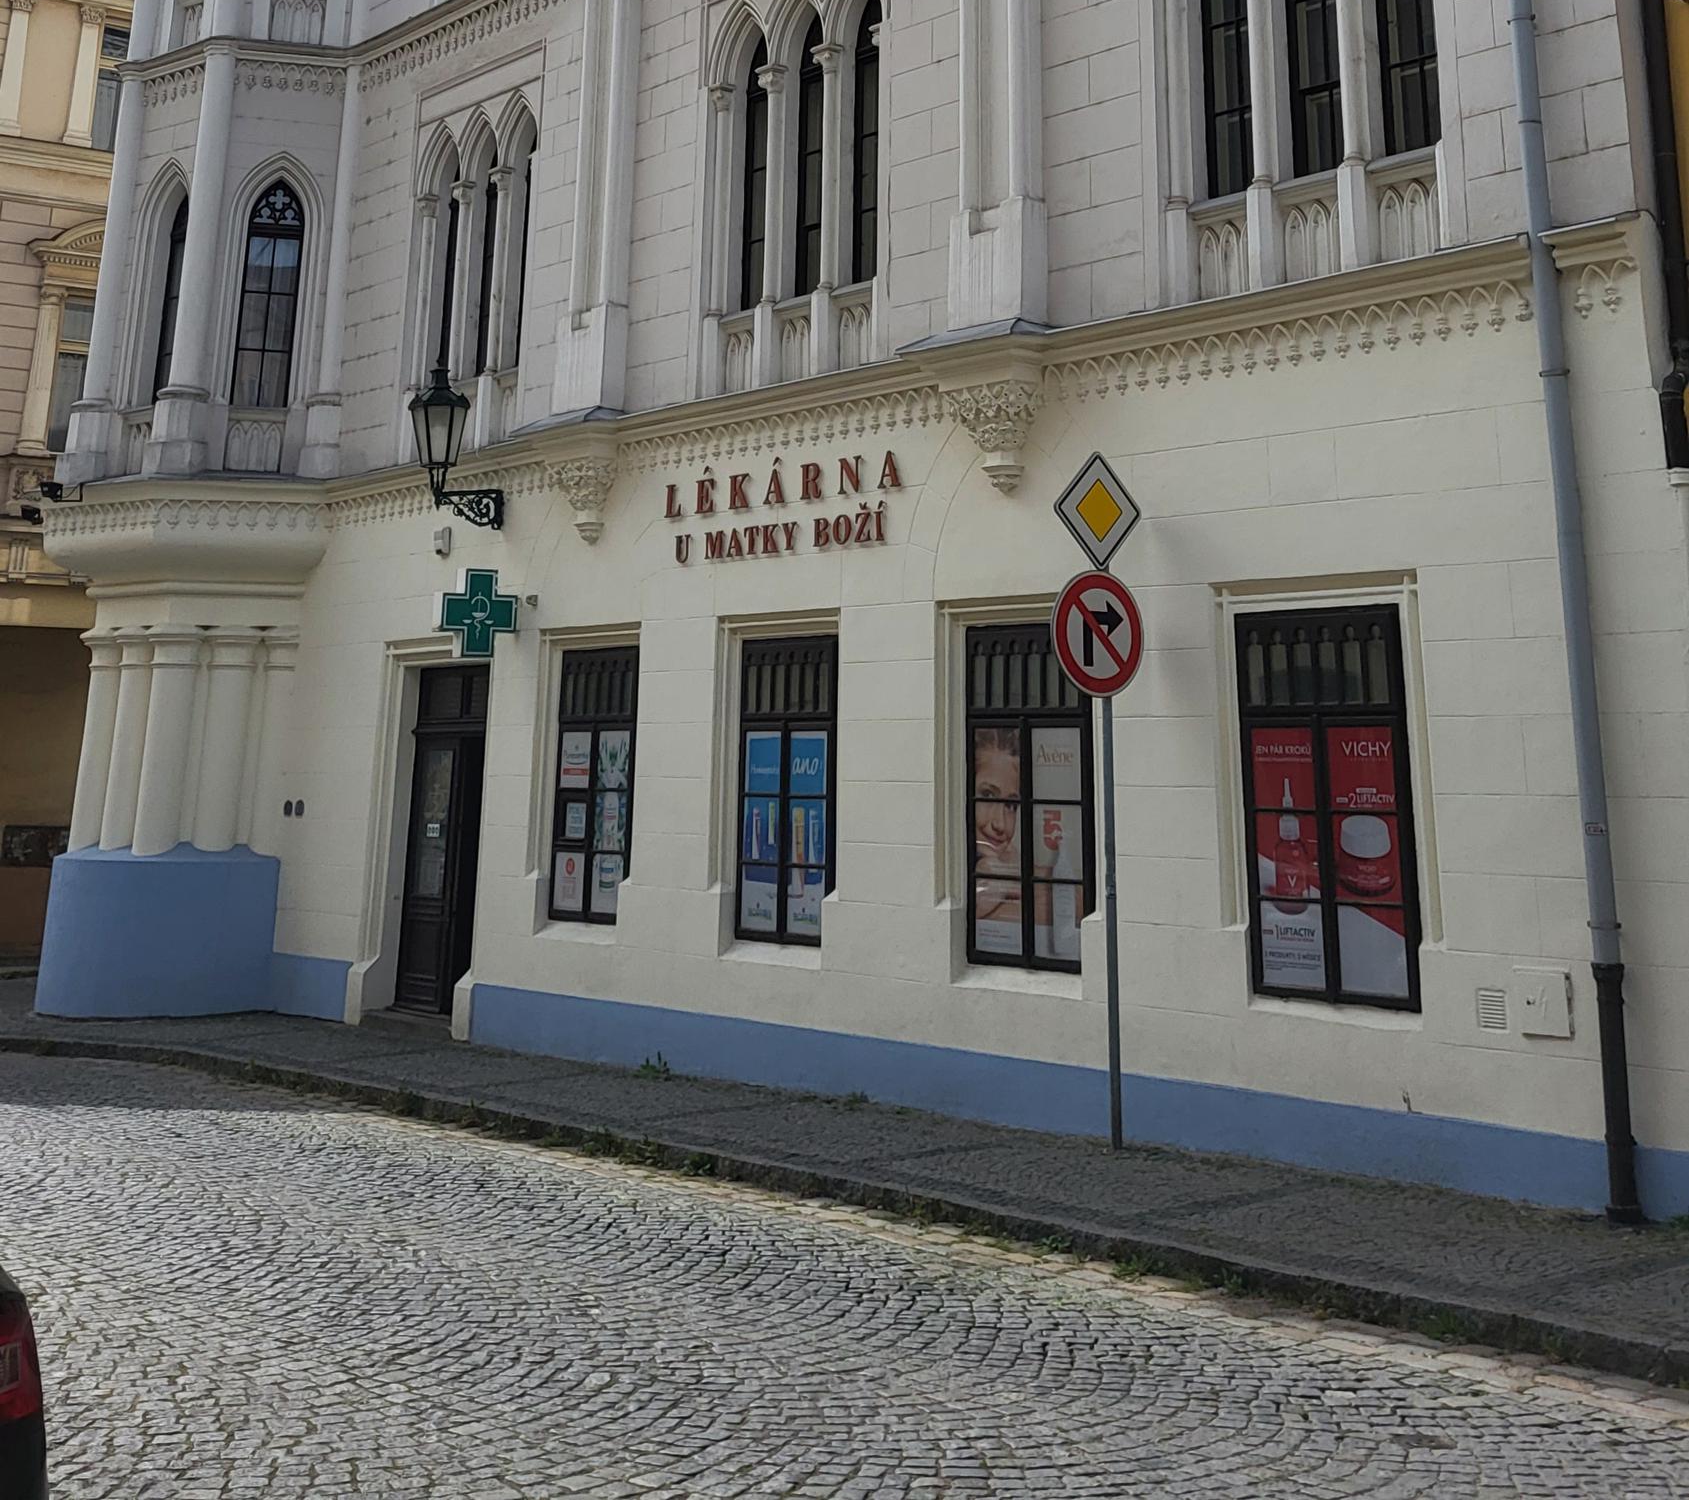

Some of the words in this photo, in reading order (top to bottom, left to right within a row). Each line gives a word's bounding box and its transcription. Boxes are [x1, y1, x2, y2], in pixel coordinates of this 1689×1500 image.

[663, 450, 902, 519] LÉKÁRNA
[675, 533, 691, 564] U
[704, 521, 798, 560] MATKY
[813, 500, 888, 548] BOŽÍ
[1037, 744, 1073, 764] Avène
[1341, 741, 1392, 757] VICHY
[1348, 793, 1357, 808] 2
[1357, 794, 1396, 804] LIFTACTIV
[1280, 926, 1316, 938] LIFTACTIV
